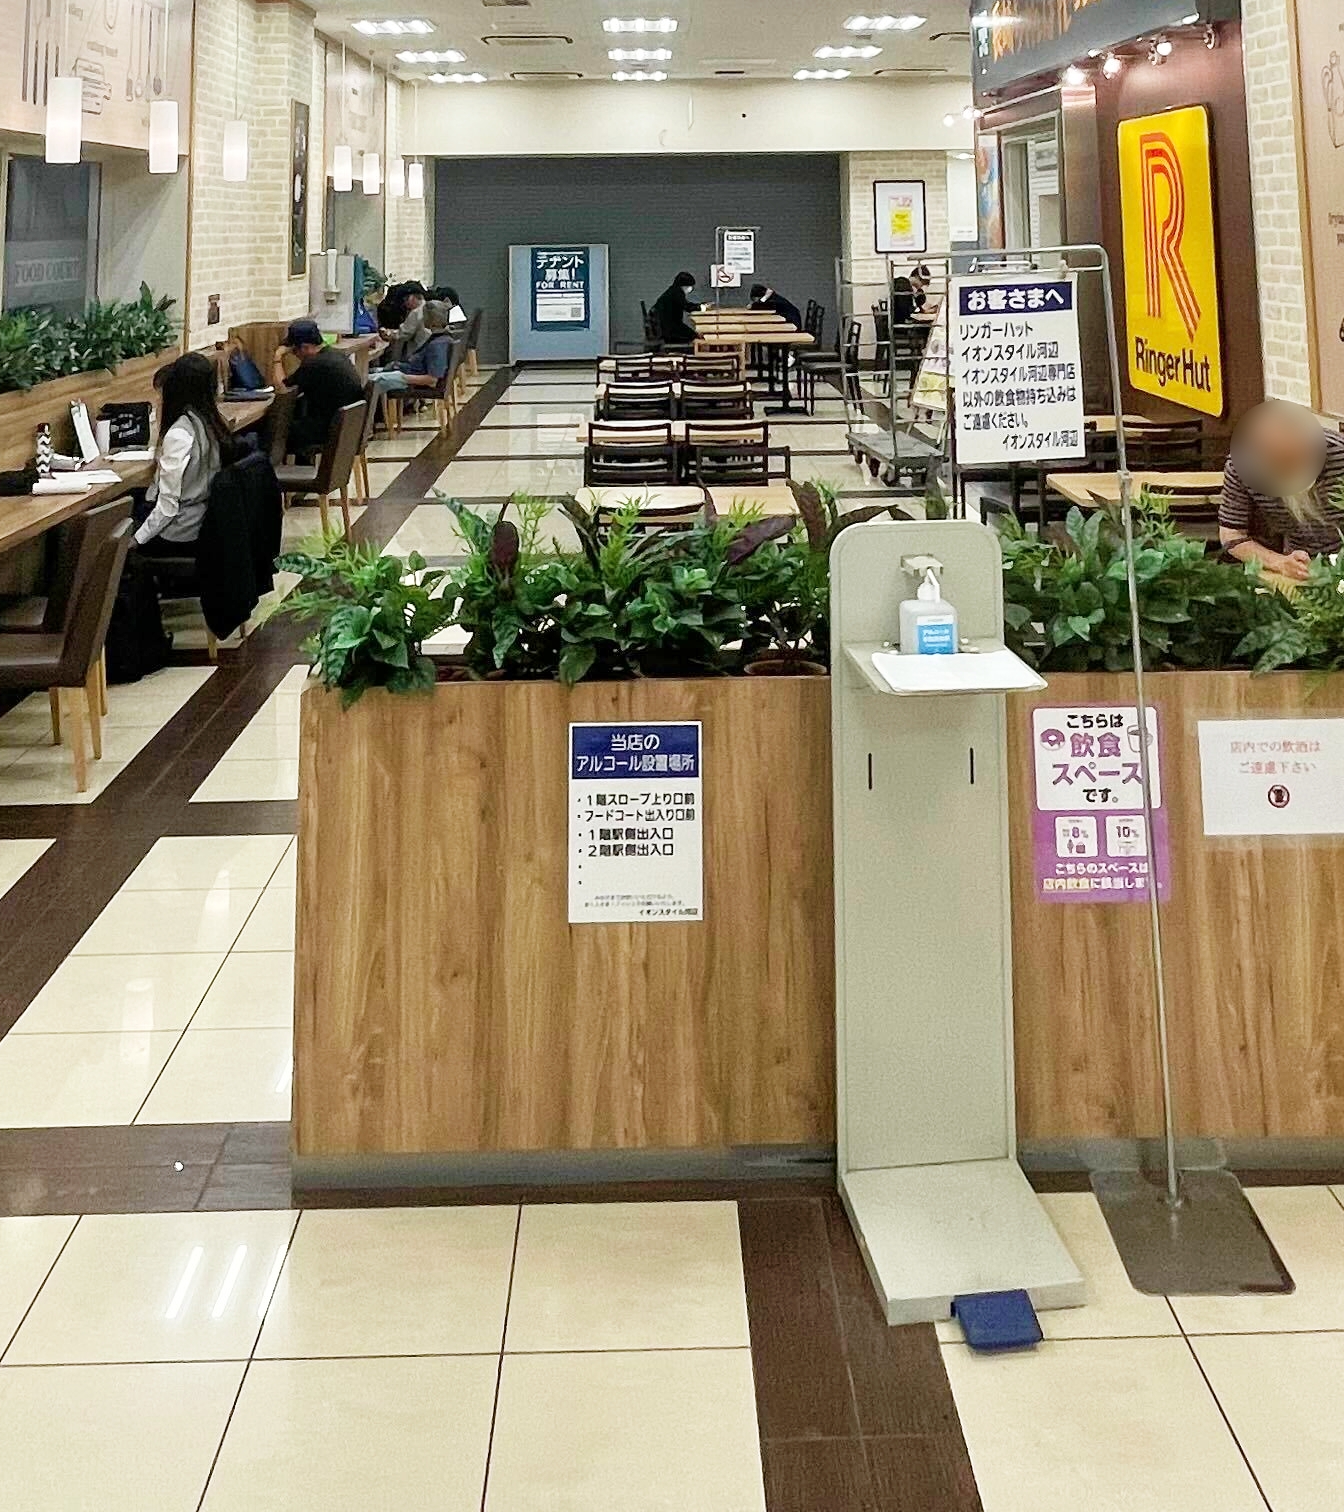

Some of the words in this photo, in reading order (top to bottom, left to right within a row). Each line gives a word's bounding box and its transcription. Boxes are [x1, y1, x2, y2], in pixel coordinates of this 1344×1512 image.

[536, 255, 585, 269] テナント
[536, 281, 555, 289] FOR
[559, 281, 585, 289] RENT
[967, 288, 1065, 312] お客さまへ
[959, 321, 1033, 341] リンガーハット
[961, 342, 1059, 363] イオンスタイル河辺
[961, 363, 1076, 383] イオンスタイル河辺専門店
[962, 386, 1077, 408] 以外の飲食物持ち込みは
[1002, 428, 1079, 450] イオンスタイル河辺
[1067, 714, 1124, 729] こちらは
[610, 734, 661, 751] 当店の
[1070, 732, 1122, 758] 飲食
[576, 754, 695, 773] アルコール設置場所
[1052, 761, 1144, 786] スペース
[1082, 788, 1119, 804] です。
